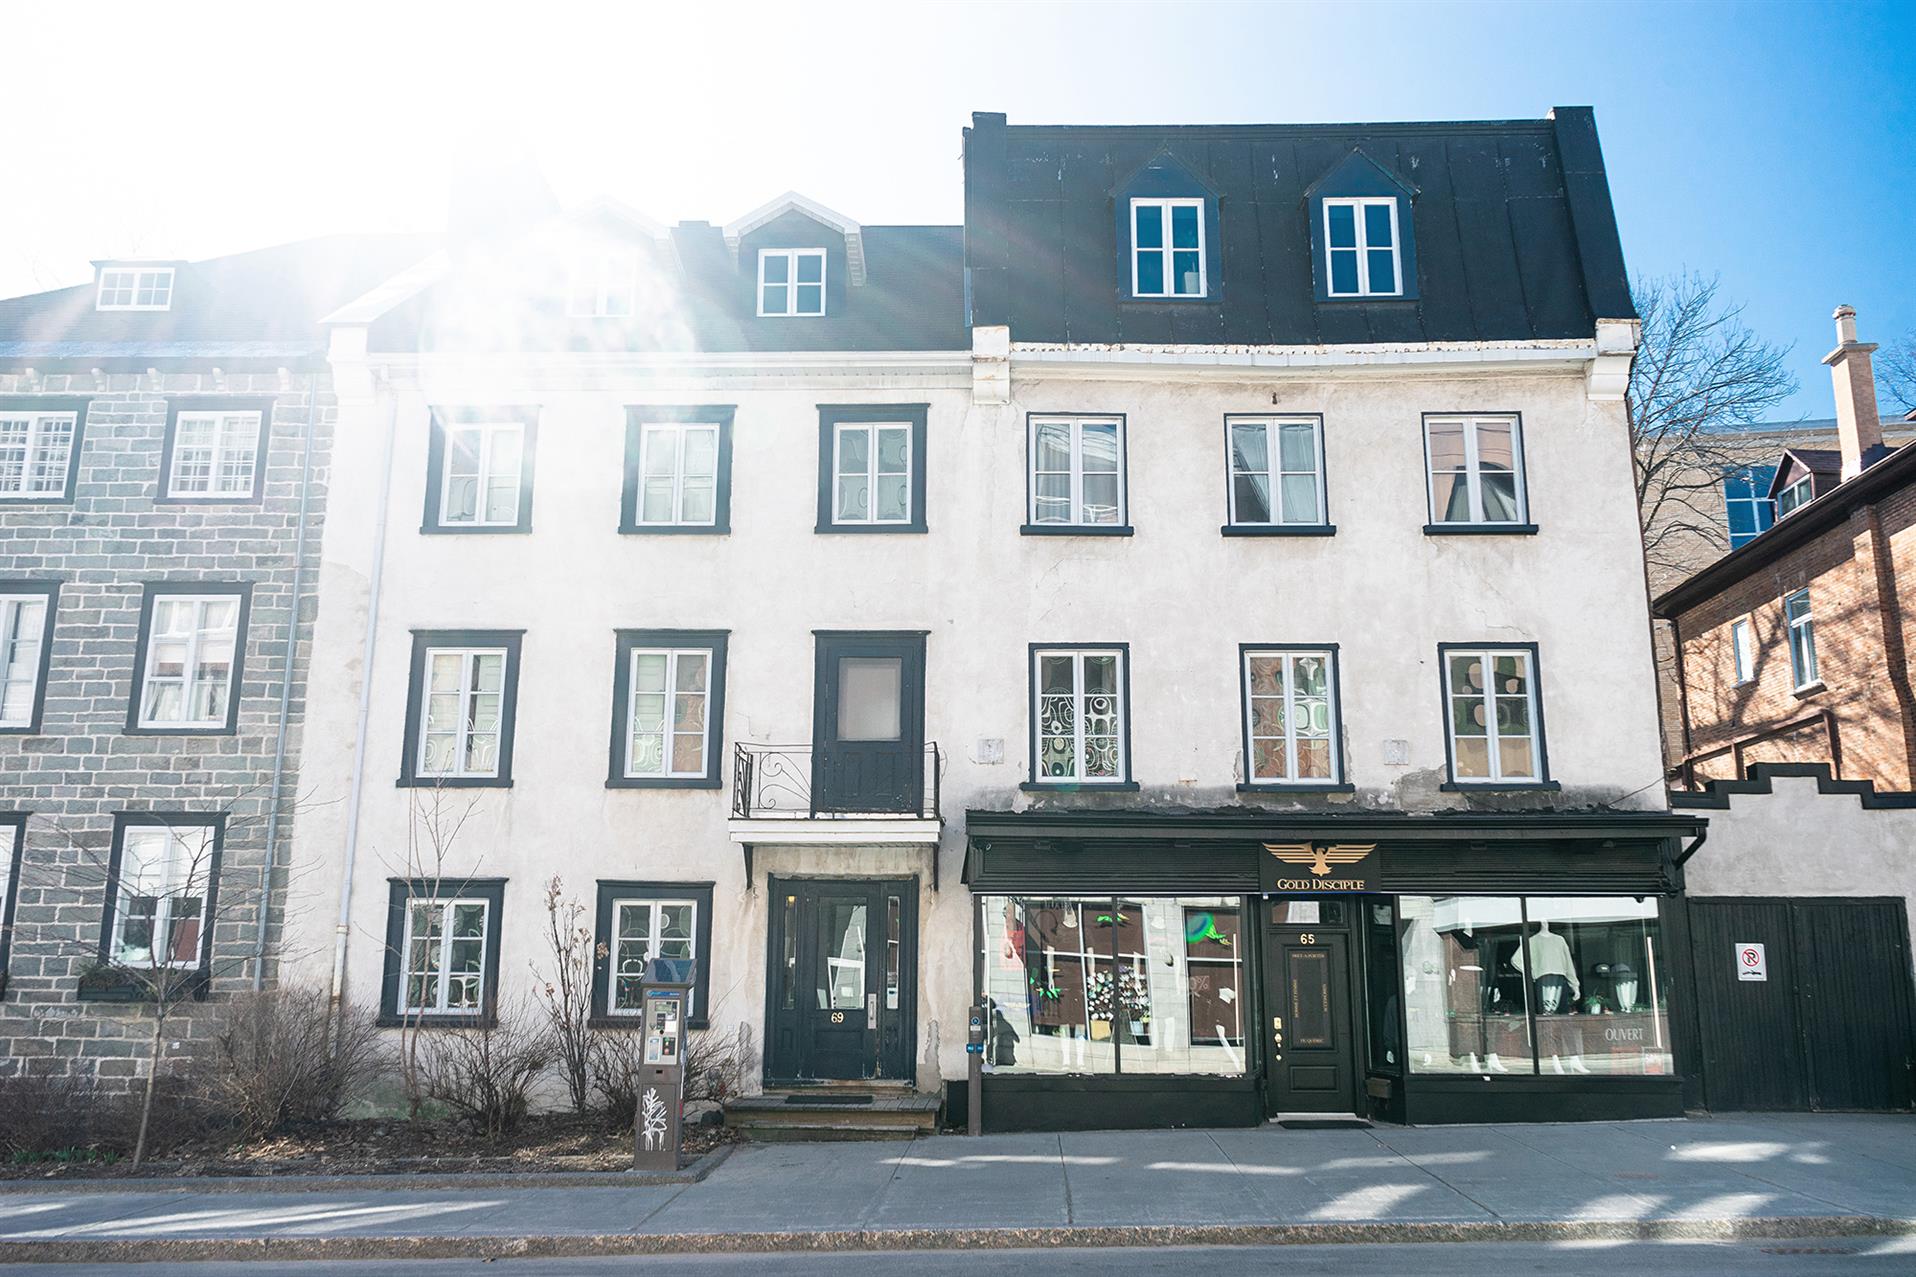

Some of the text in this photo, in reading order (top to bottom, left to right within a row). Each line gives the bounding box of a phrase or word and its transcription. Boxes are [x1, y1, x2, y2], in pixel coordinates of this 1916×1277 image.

[1277, 878, 1365, 890] GOLD DISCIPLE
[1300, 933, 1315, 945] 65
[831, 1011, 844, 1023] 69
[1605, 1027, 1643, 1041] OUVERT
